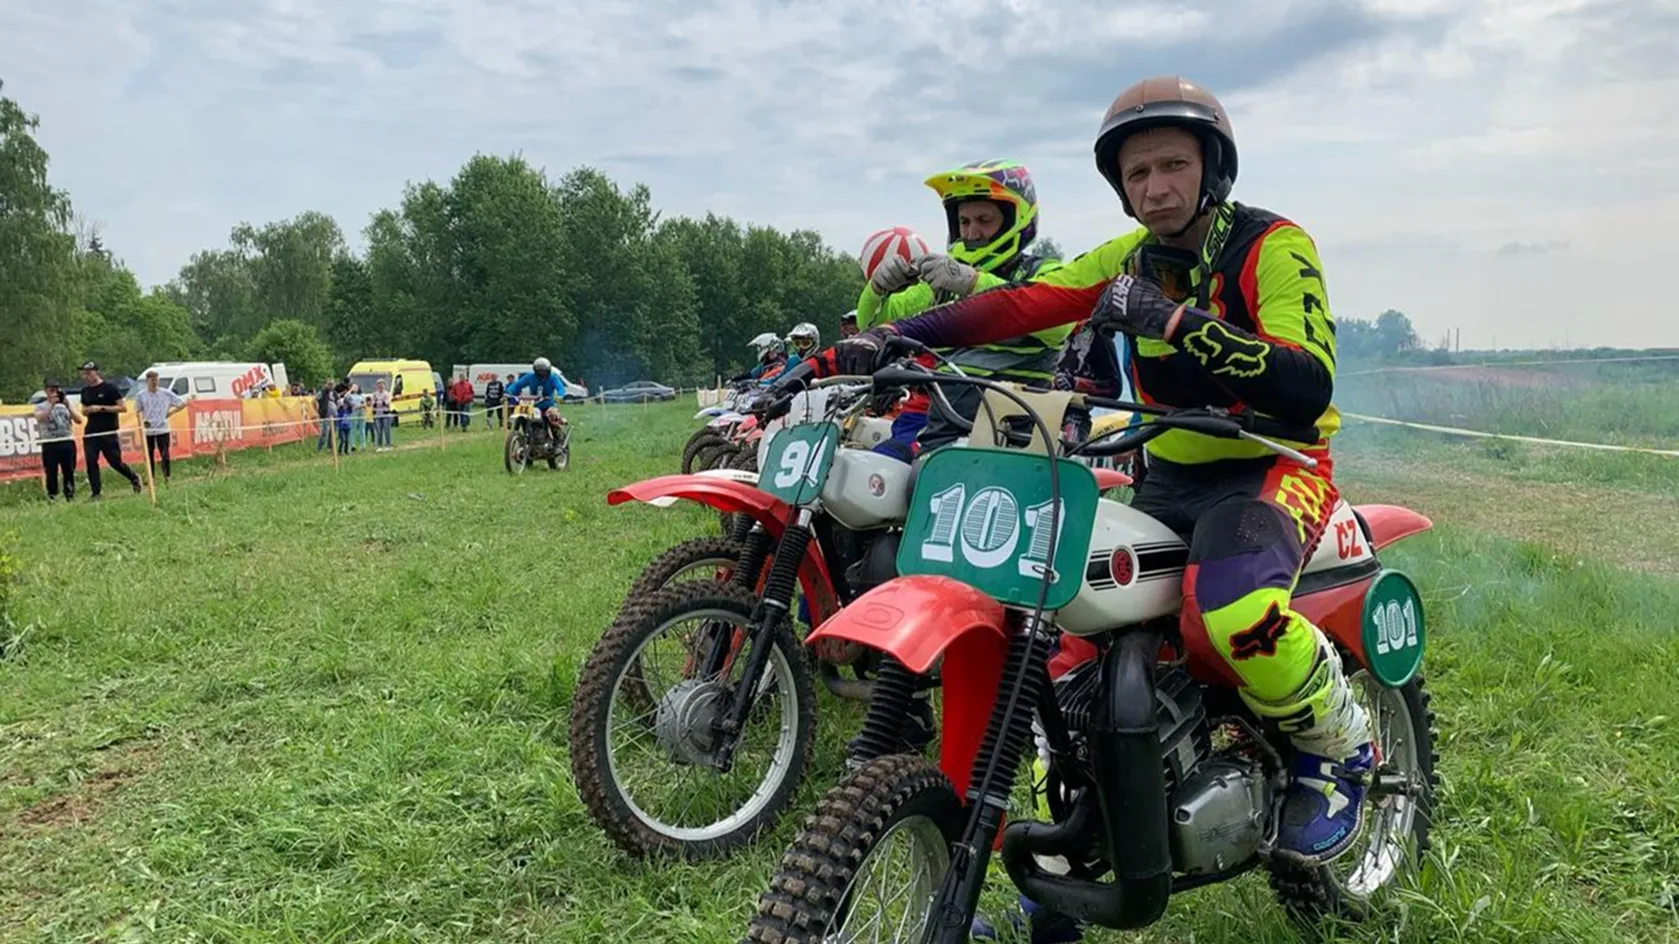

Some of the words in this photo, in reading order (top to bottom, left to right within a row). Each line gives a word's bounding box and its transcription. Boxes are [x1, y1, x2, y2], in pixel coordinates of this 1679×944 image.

[775, 436, 828, 489] 91
[921, 482, 1066, 584] 101
[1372, 596, 1418, 655] 101
